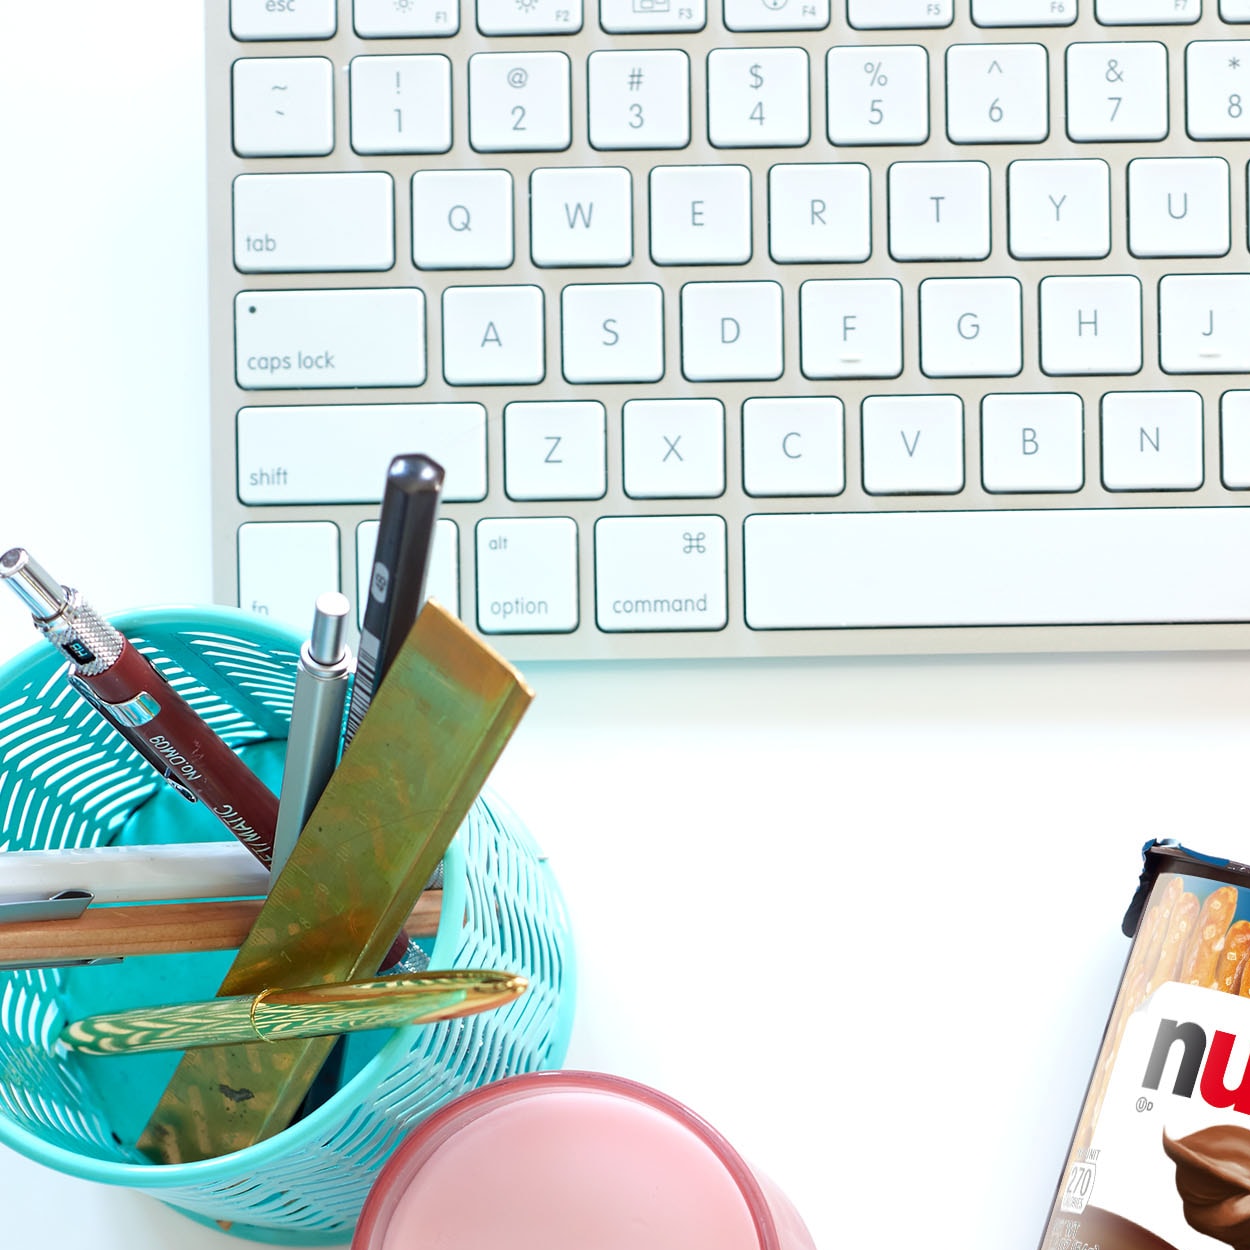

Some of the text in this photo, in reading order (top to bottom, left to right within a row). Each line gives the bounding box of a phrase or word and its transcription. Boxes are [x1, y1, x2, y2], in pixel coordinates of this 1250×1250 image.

[265, 0, 295, 13] esc
[434, 10, 448, 24] F1
[554, 9, 570, 23] F2
[677, 7, 693, 20] F3
[925, 4, 942, 17] F5
[1049, 2, 1066, 15] F6
[510, 105, 527, 131] 2
[628, 103, 645, 129] 3
[748, 101, 766, 126] 4
[868, 99, 884, 126] 5
[988, 97, 1004, 123] 6
[1107, 96, 1123, 122] 7
[1227, 93, 1243, 119] 8
[393, 108, 403, 133] 1
[447, 204, 472, 232] Q
[564, 201, 594, 230] W
[691, 200, 705, 227] E
[810, 198, 827, 225] R
[929, 196, 946, 224] T
[1048, 194, 1067, 222] Y
[1167, 191, 1188, 220] U
[246, 234, 277, 252] tab
[480, 320, 503, 348] A
[602, 318, 620, 347] S
[720, 316, 741, 345] D
[842, 315, 857, 342] F
[956, 312, 980, 341] G
[1077, 309, 1098, 337] H
[1201, 309, 1214, 337] J
[247, 351, 335, 374] caps lock
[543, 436, 563, 464] Z
[662, 435, 684, 463] X
[781, 431, 803, 460] C
[900, 430, 921, 458] V
[1021, 427, 1040, 456] B
[1139, 426, 1160, 453] N
[250, 467, 288, 486] shift
[488, 537, 508, 550] alt
[490, 599, 548, 619] option
[612, 593, 708, 614] command
